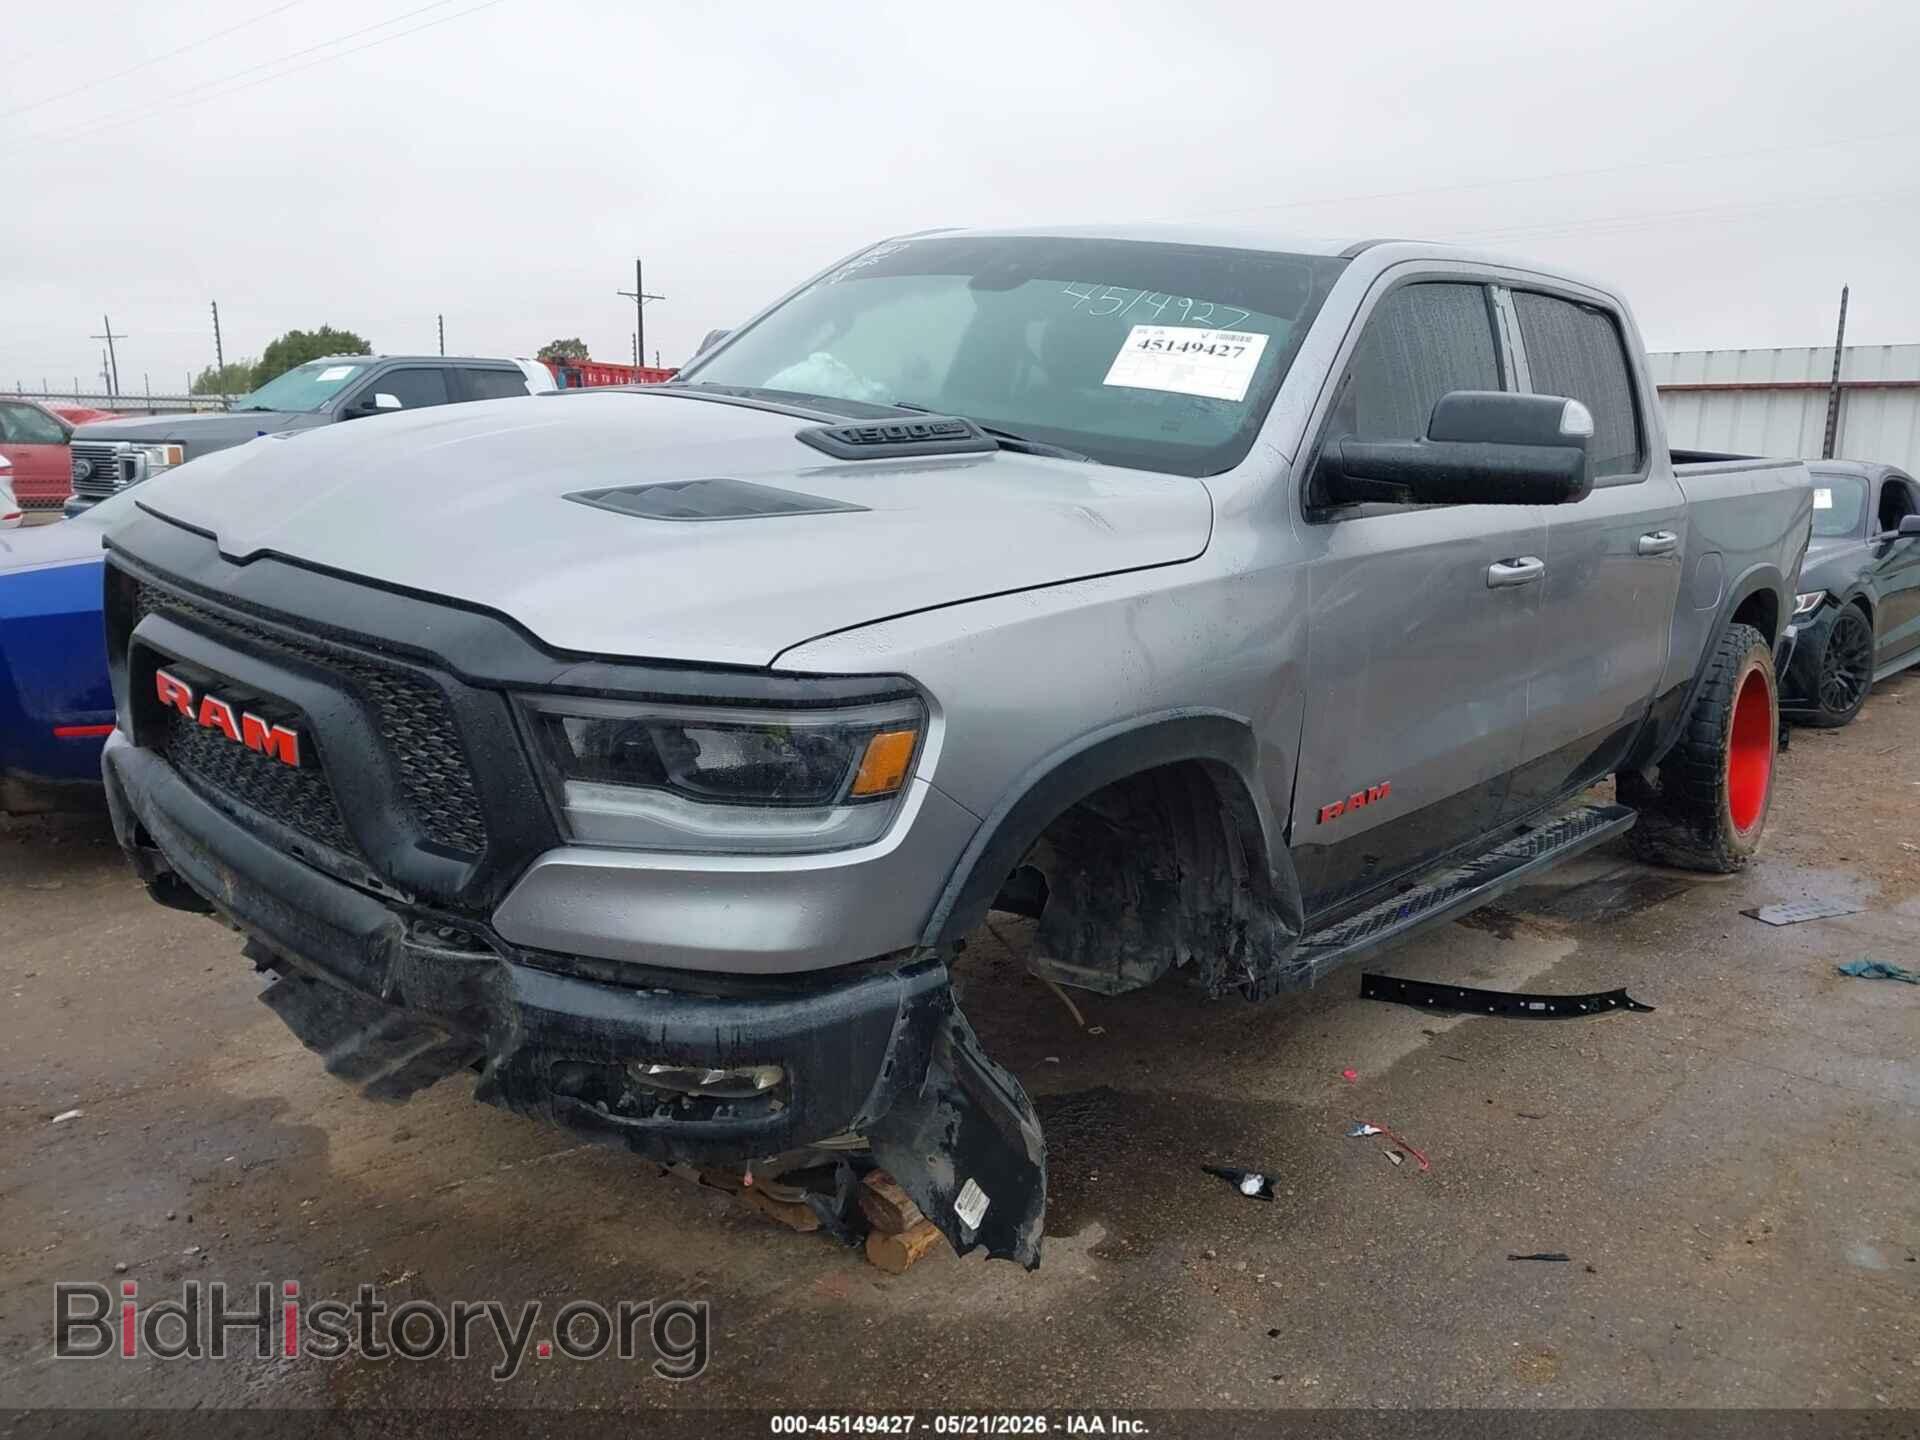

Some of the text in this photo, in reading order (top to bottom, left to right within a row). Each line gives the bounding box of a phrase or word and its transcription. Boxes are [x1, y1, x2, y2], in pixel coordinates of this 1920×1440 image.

[1136, 338, 1247, 359] 45149427
[156, 669, 300, 767] RAM
[1318, 780, 1392, 825] RAM
